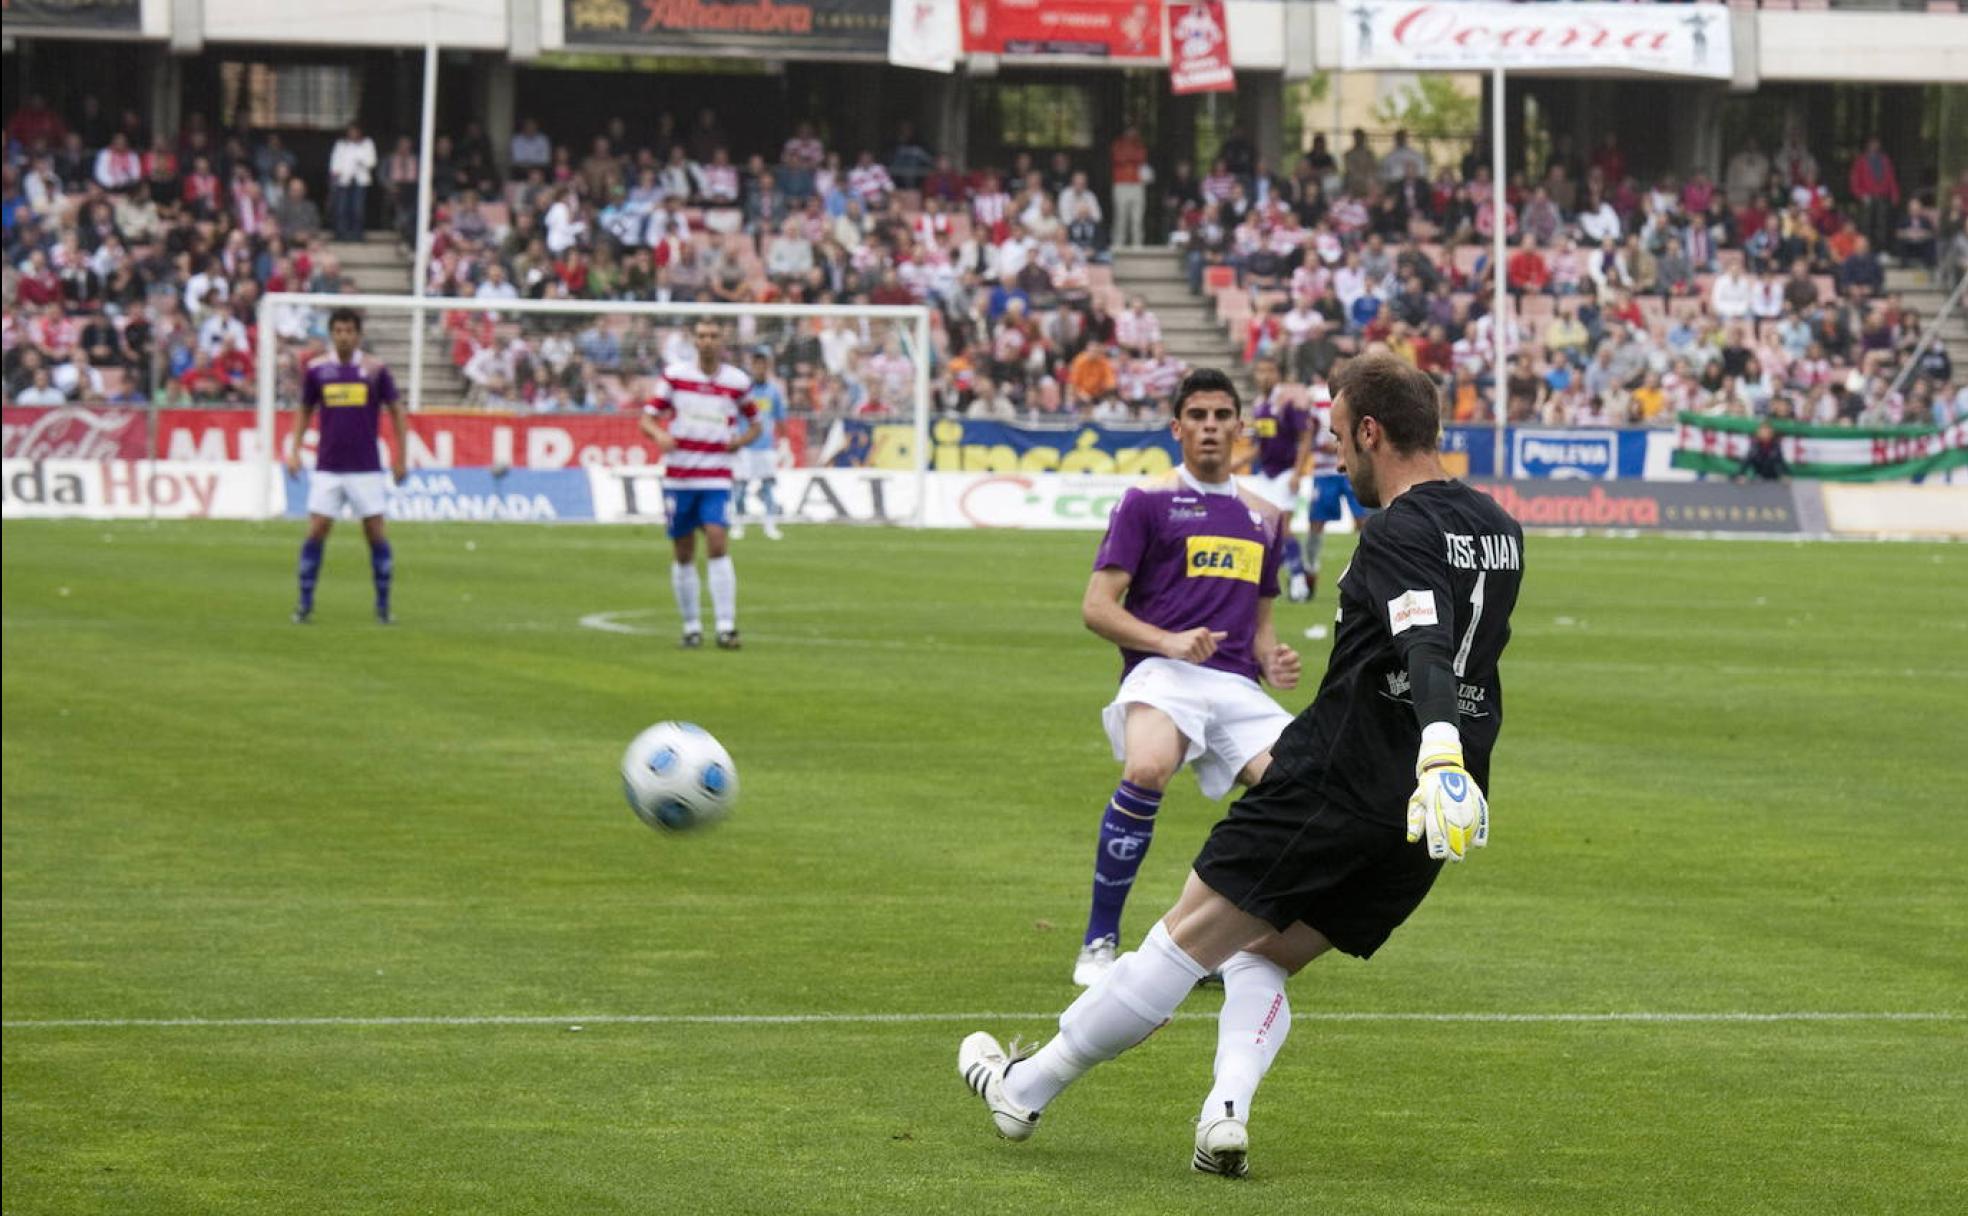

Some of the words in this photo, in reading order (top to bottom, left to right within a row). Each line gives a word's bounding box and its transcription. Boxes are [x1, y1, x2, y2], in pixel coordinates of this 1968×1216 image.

[5, 406, 137, 460] Cola
[101, 460, 219, 519] Hoy
[1192, 551, 1234, 569] GEA
[1480, 534, 1519, 571] JUAN
[1453, 571, 1486, 677] 1
